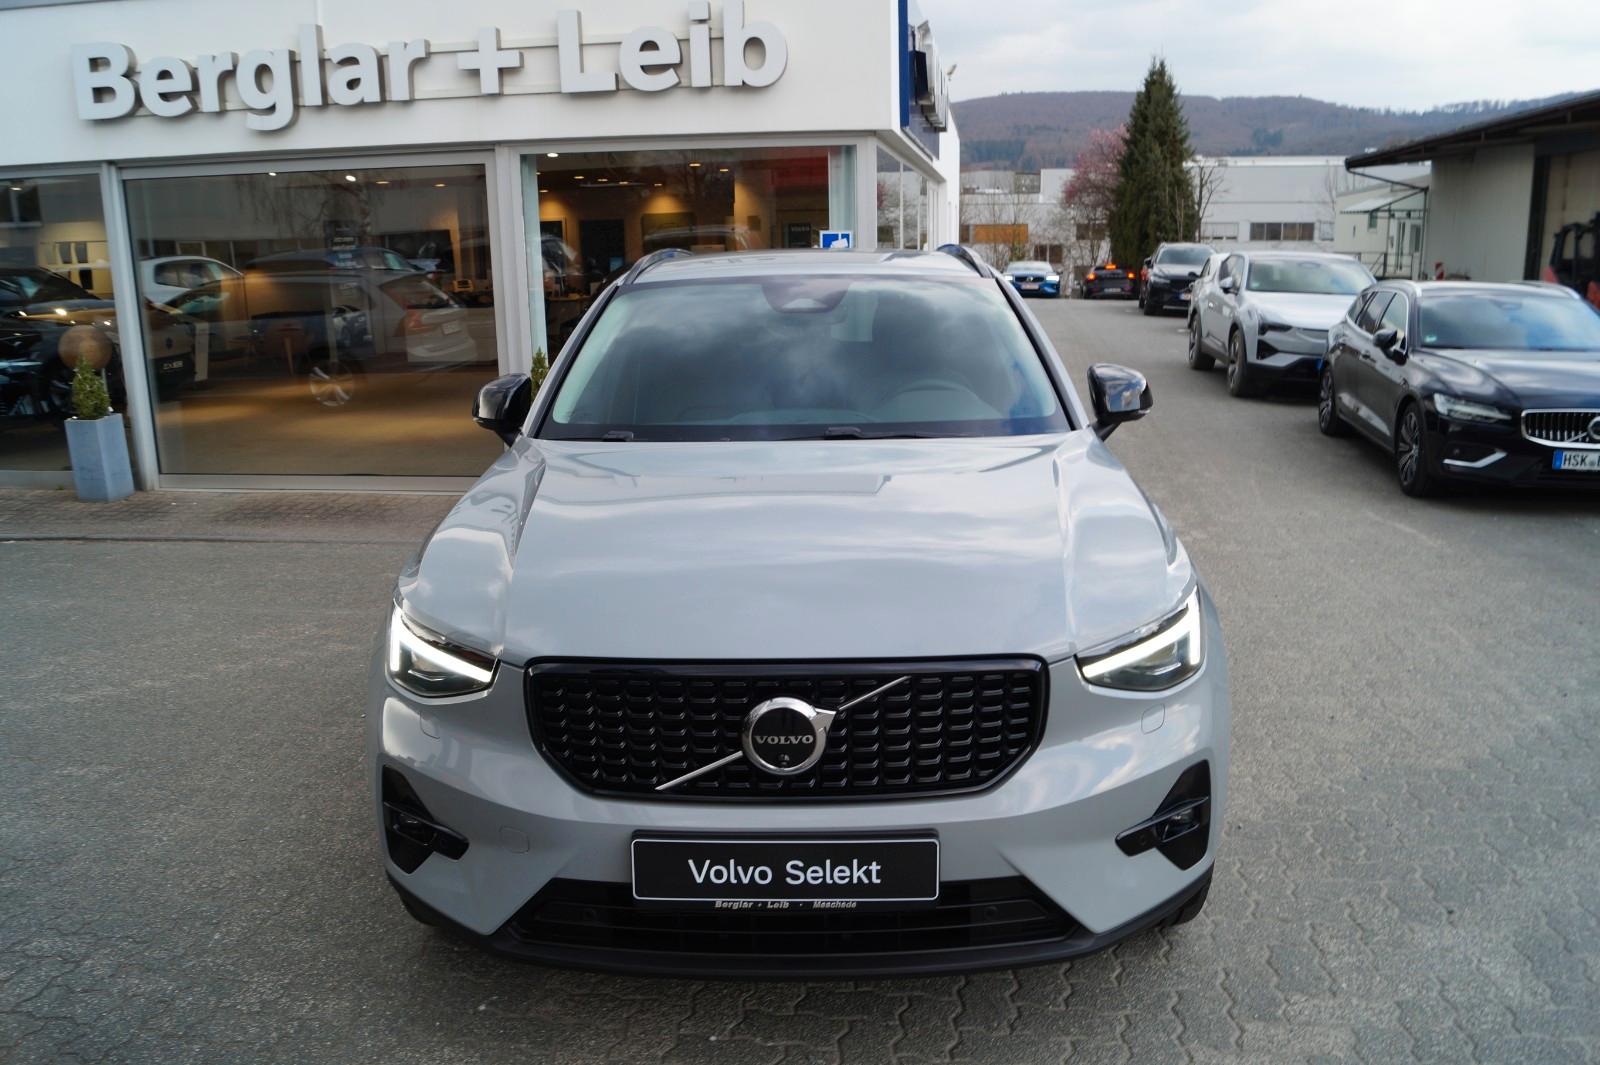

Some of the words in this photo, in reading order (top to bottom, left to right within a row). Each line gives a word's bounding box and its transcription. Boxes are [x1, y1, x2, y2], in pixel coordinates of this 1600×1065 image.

[71, 24, 430, 131] Berglar
[558, 0, 788, 93] Leib
[1563, 454, 1588, 466] HSK
[754, 735, 814, 744] VOLVO
[688, 858, 773, 884] Volvo
[785, 859, 881, 884] Selekt
